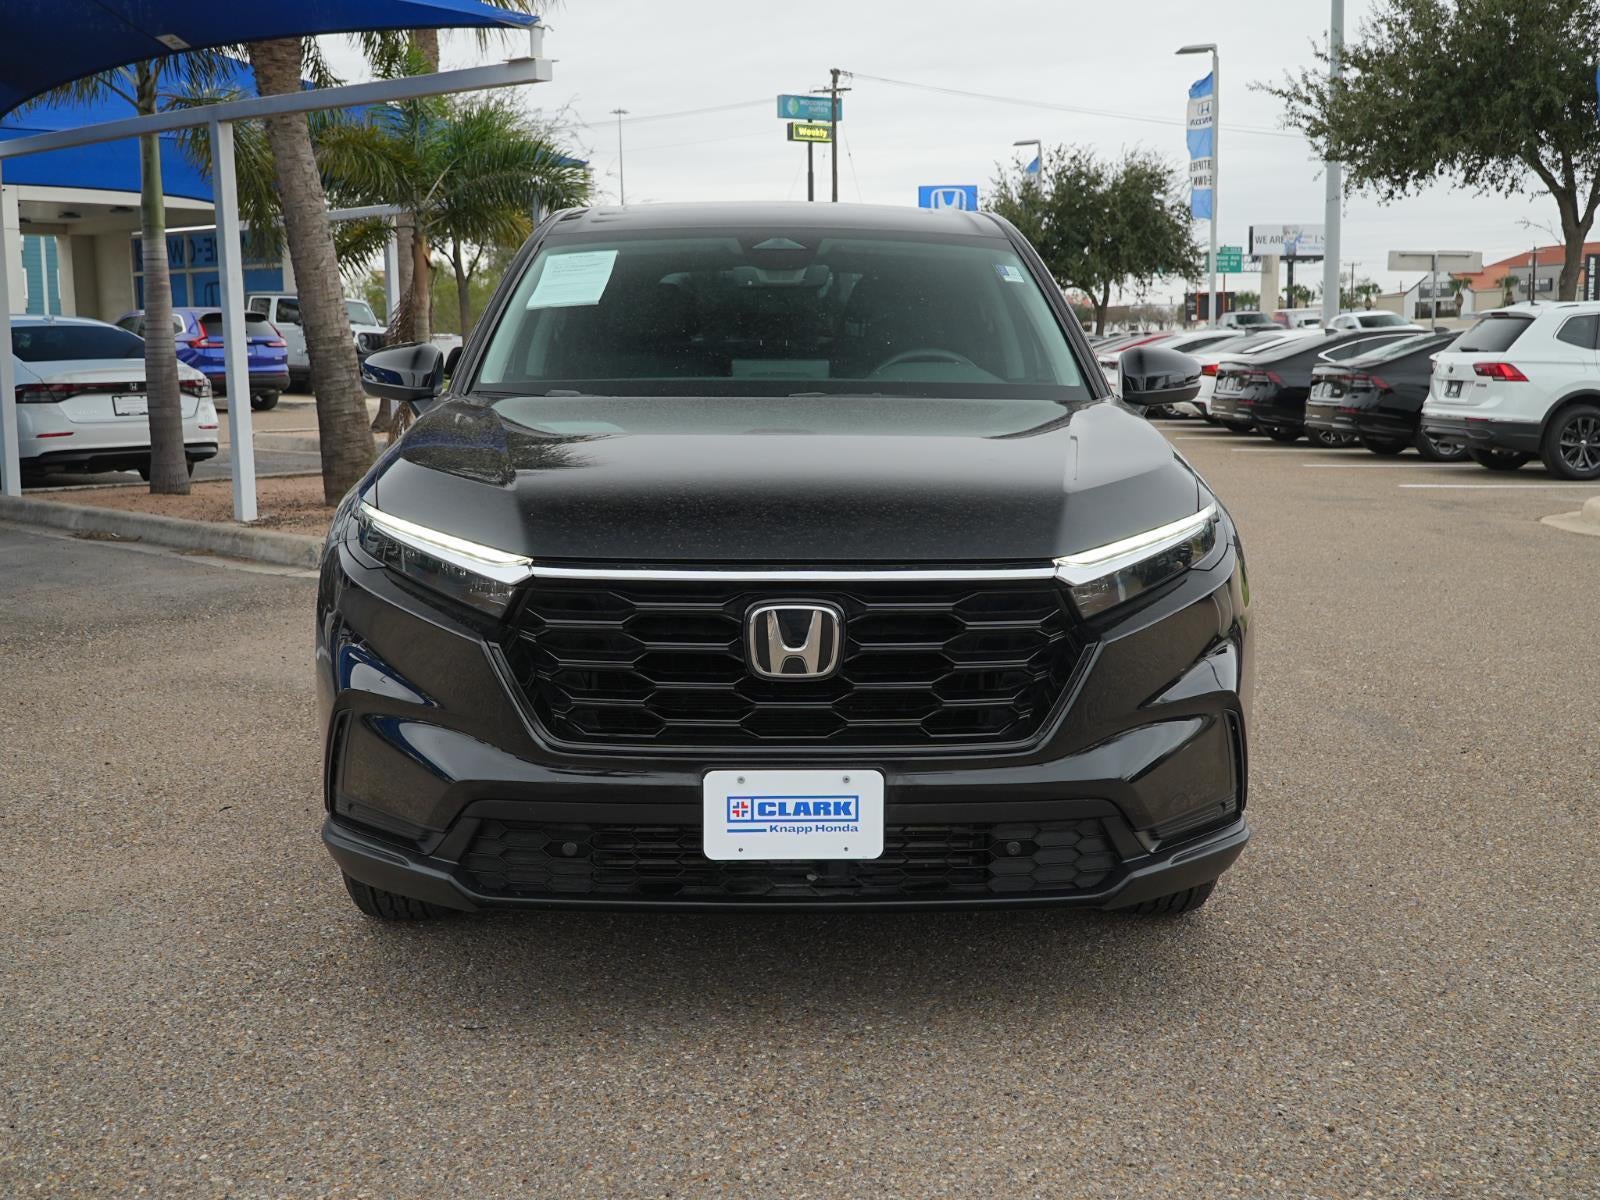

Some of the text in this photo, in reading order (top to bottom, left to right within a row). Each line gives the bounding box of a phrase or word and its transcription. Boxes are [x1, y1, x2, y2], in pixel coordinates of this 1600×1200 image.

[798, 127, 828, 138] Weekly
[1255, 235, 1267, 245] WE
[757, 801, 852, 816] CLARK
[769, 823, 859, 834] Knapp Honda
